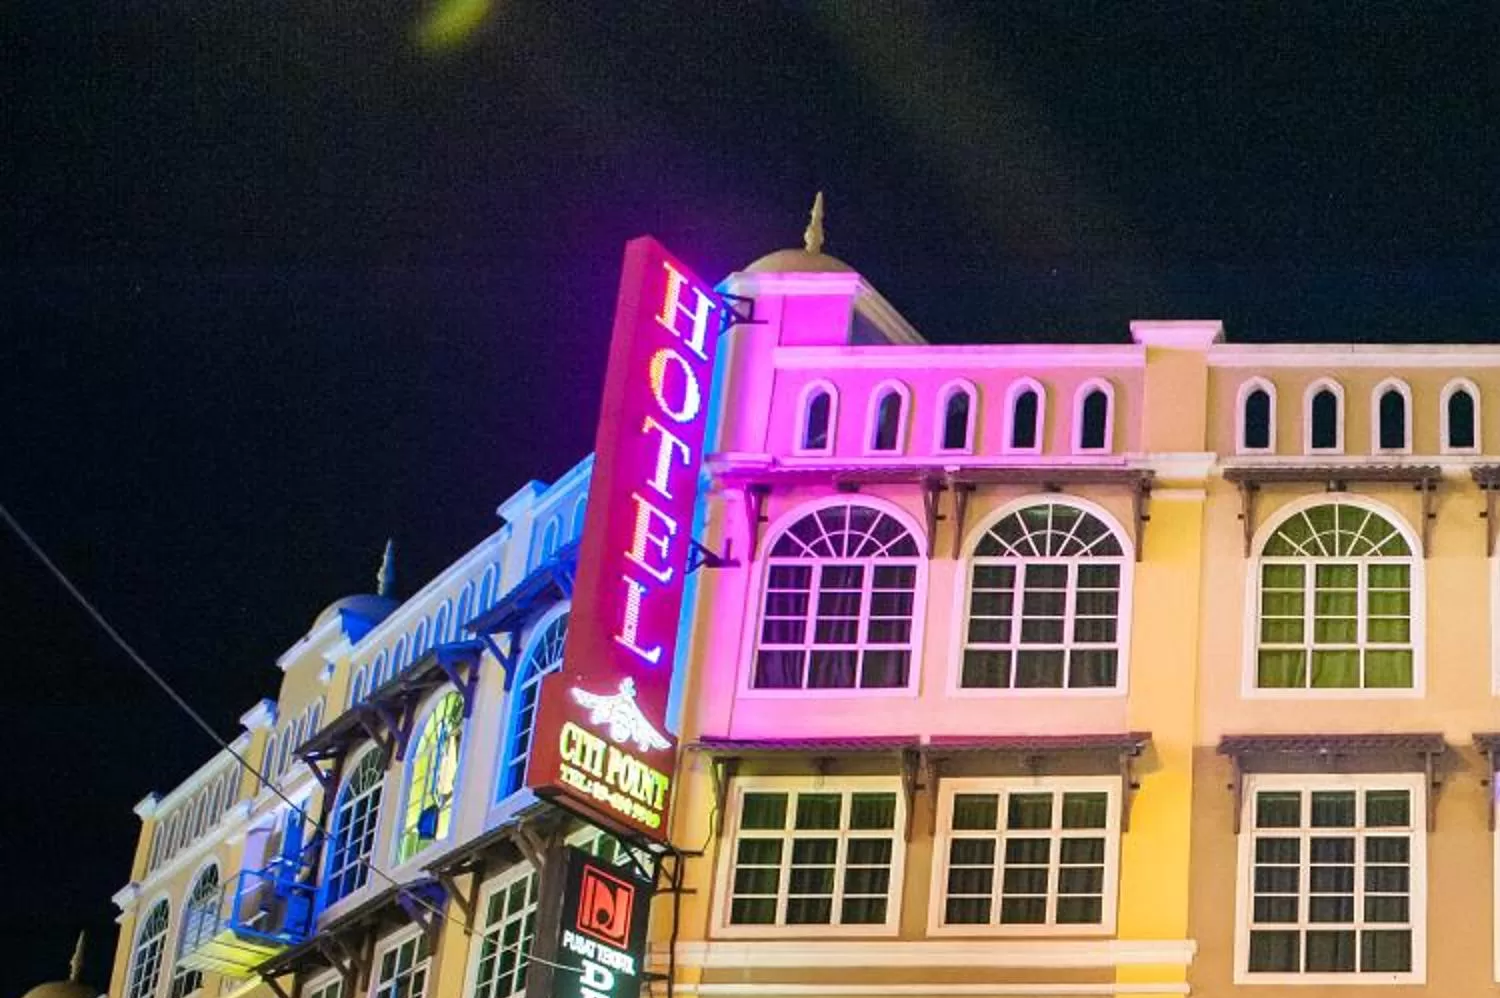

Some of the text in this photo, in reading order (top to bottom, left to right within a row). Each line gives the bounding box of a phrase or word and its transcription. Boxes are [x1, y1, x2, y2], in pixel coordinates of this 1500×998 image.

[612, 260, 718, 666] HOTEL
[559, 721, 608, 778] CITI
[605, 746, 670, 811] POINT
